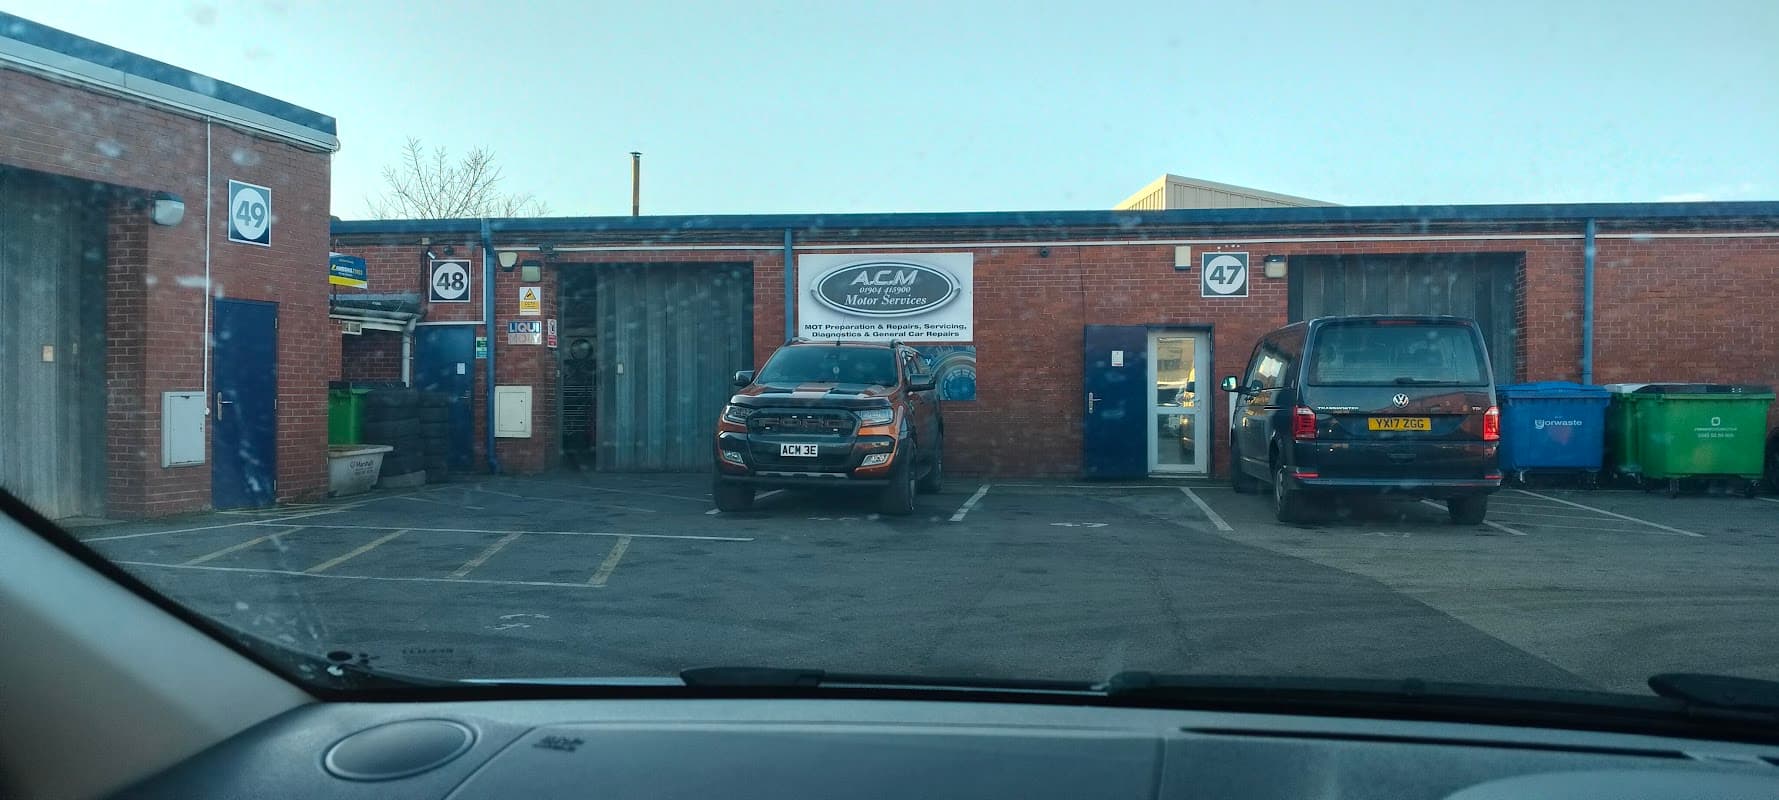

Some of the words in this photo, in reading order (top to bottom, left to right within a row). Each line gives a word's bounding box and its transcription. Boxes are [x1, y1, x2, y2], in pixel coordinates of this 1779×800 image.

[236, 200, 266, 228] 49
[436, 271, 465, 291] 48
[1209, 265, 1242, 285] 47
[844, 294, 878, 306] Motor
[881, 293, 927, 306] Services
[509, 322, 540, 333] LIQUI
[923, 323, 967, 331] Servicing,
[1375, 418, 1400, 429] YX17
[1403, 418, 1424, 429] ZGG
[782, 445, 801, 455] ACM
[804, 445, 817, 455] 3E
